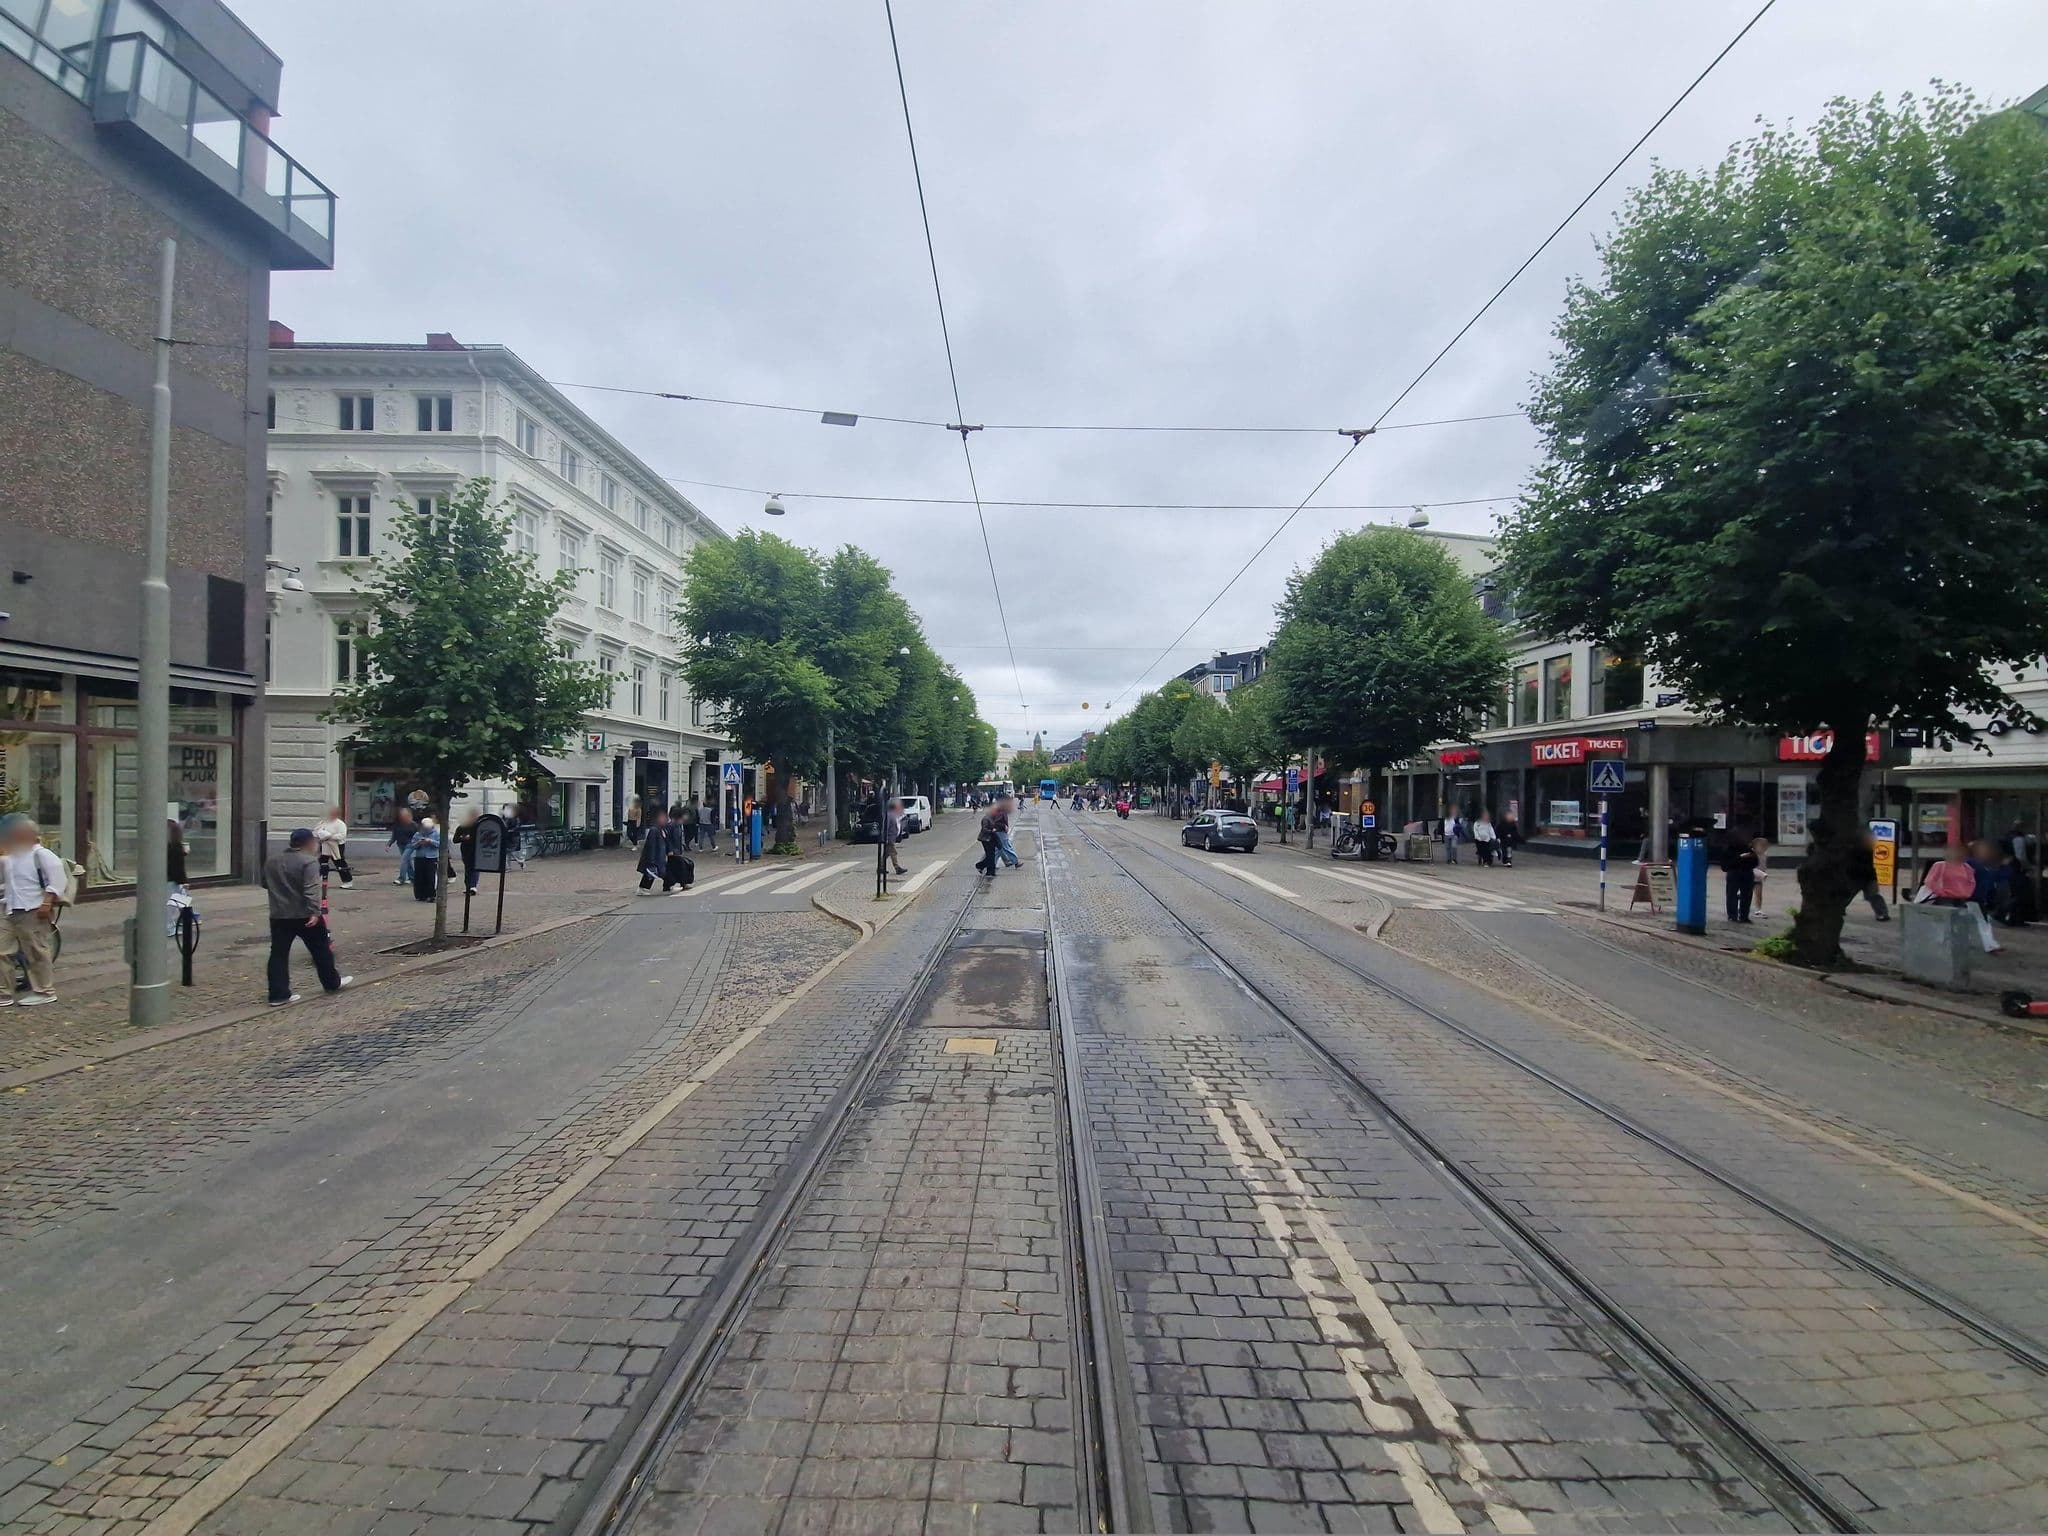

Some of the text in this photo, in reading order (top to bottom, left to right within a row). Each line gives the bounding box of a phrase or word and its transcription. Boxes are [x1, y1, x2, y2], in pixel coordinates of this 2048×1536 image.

[1534, 742, 1578, 760] TICKET
[1587, 739, 1623, 749] TICKET
[181, 747, 217, 768] PRO
